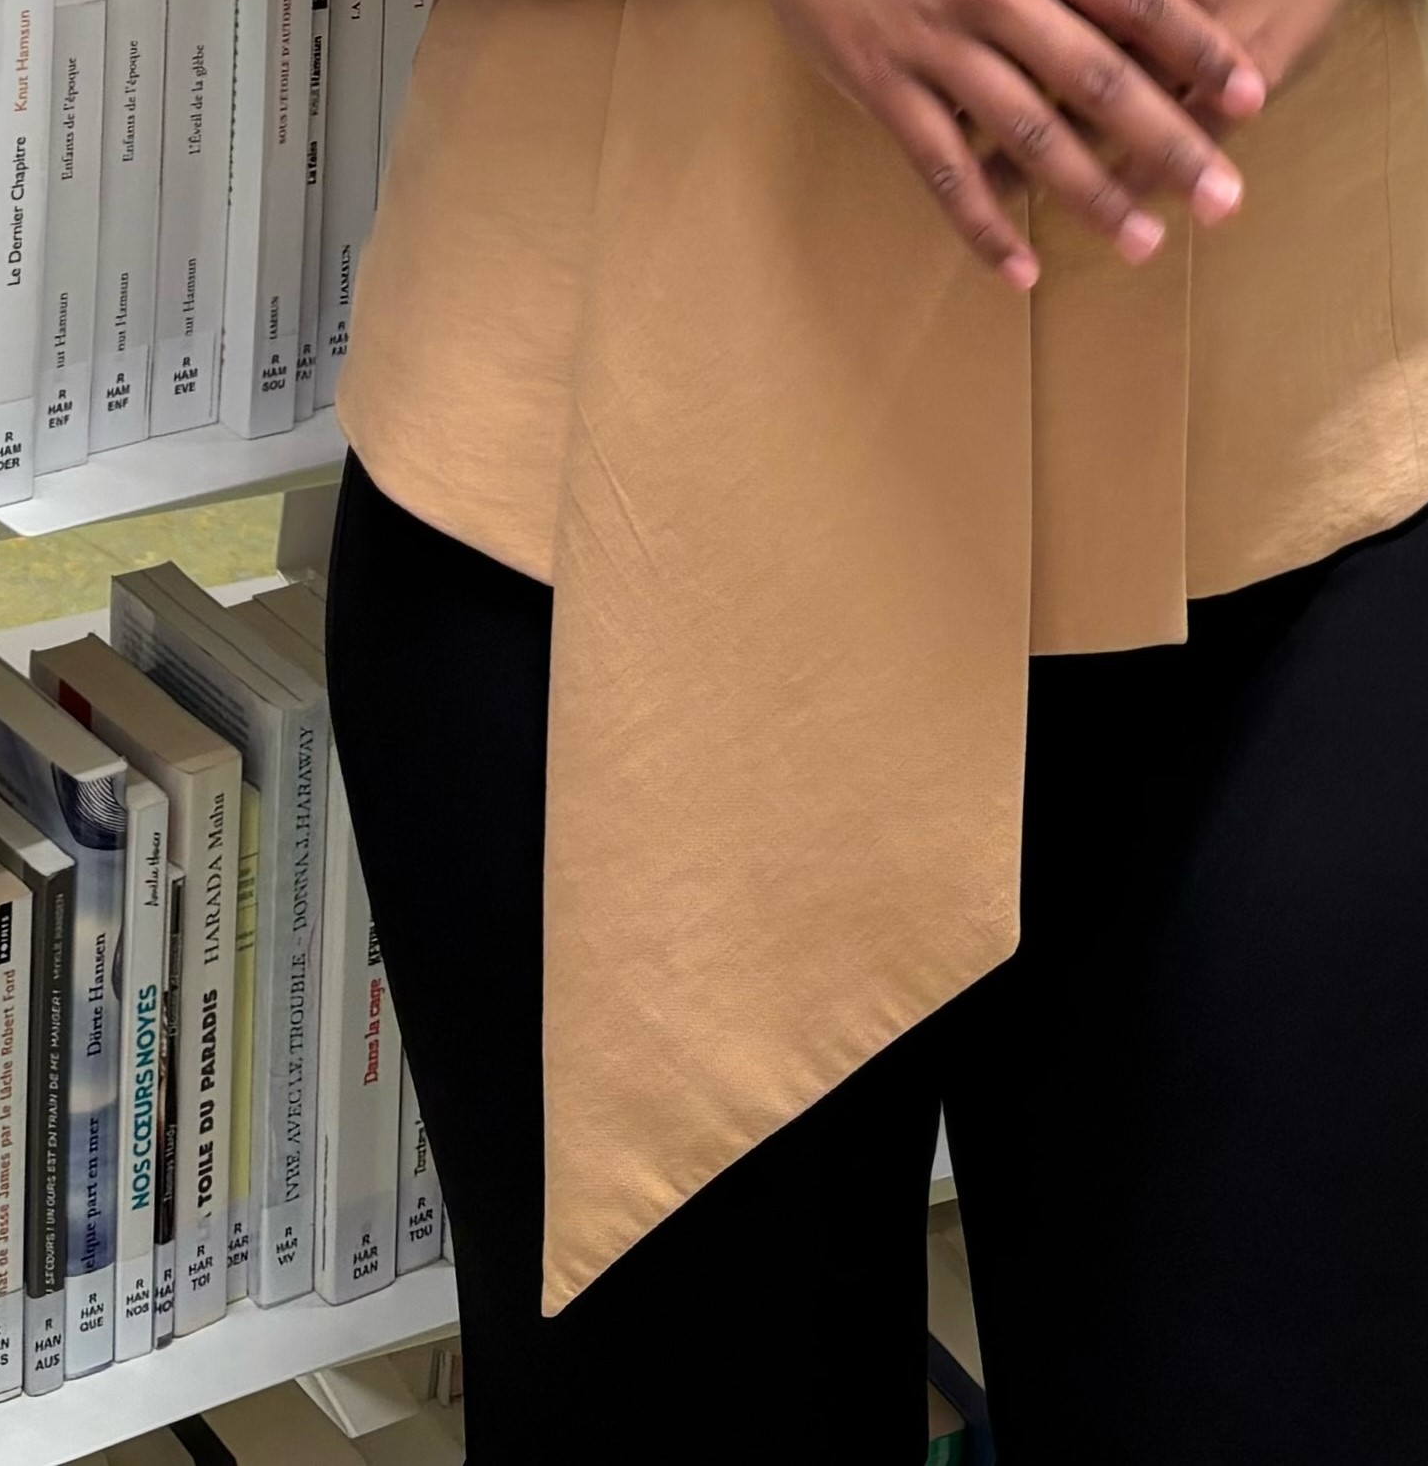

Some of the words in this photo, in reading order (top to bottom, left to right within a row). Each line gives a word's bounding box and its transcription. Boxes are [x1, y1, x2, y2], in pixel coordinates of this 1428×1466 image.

[16, 10, 31, 70] Hamsun
[14, 77, 28, 112] Knut
[11, 136, 29, 200] Chapitre
[8, 206, 24, 263] Dernier
[7, 268, 22, 286] Le
[206, 791, 226, 851] Maha
[202, 852, 224, 965] HARADA
[89, 932, 107, 1001] Hansen
[86, 1005, 105, 1057] Dörte
[200, 988, 218, 1093] PARADIS
[199, 1098, 215, 1133] DU
[130, 1157, 151, 1211] NOS
[196, 1142, 215, 1208] TOILE
